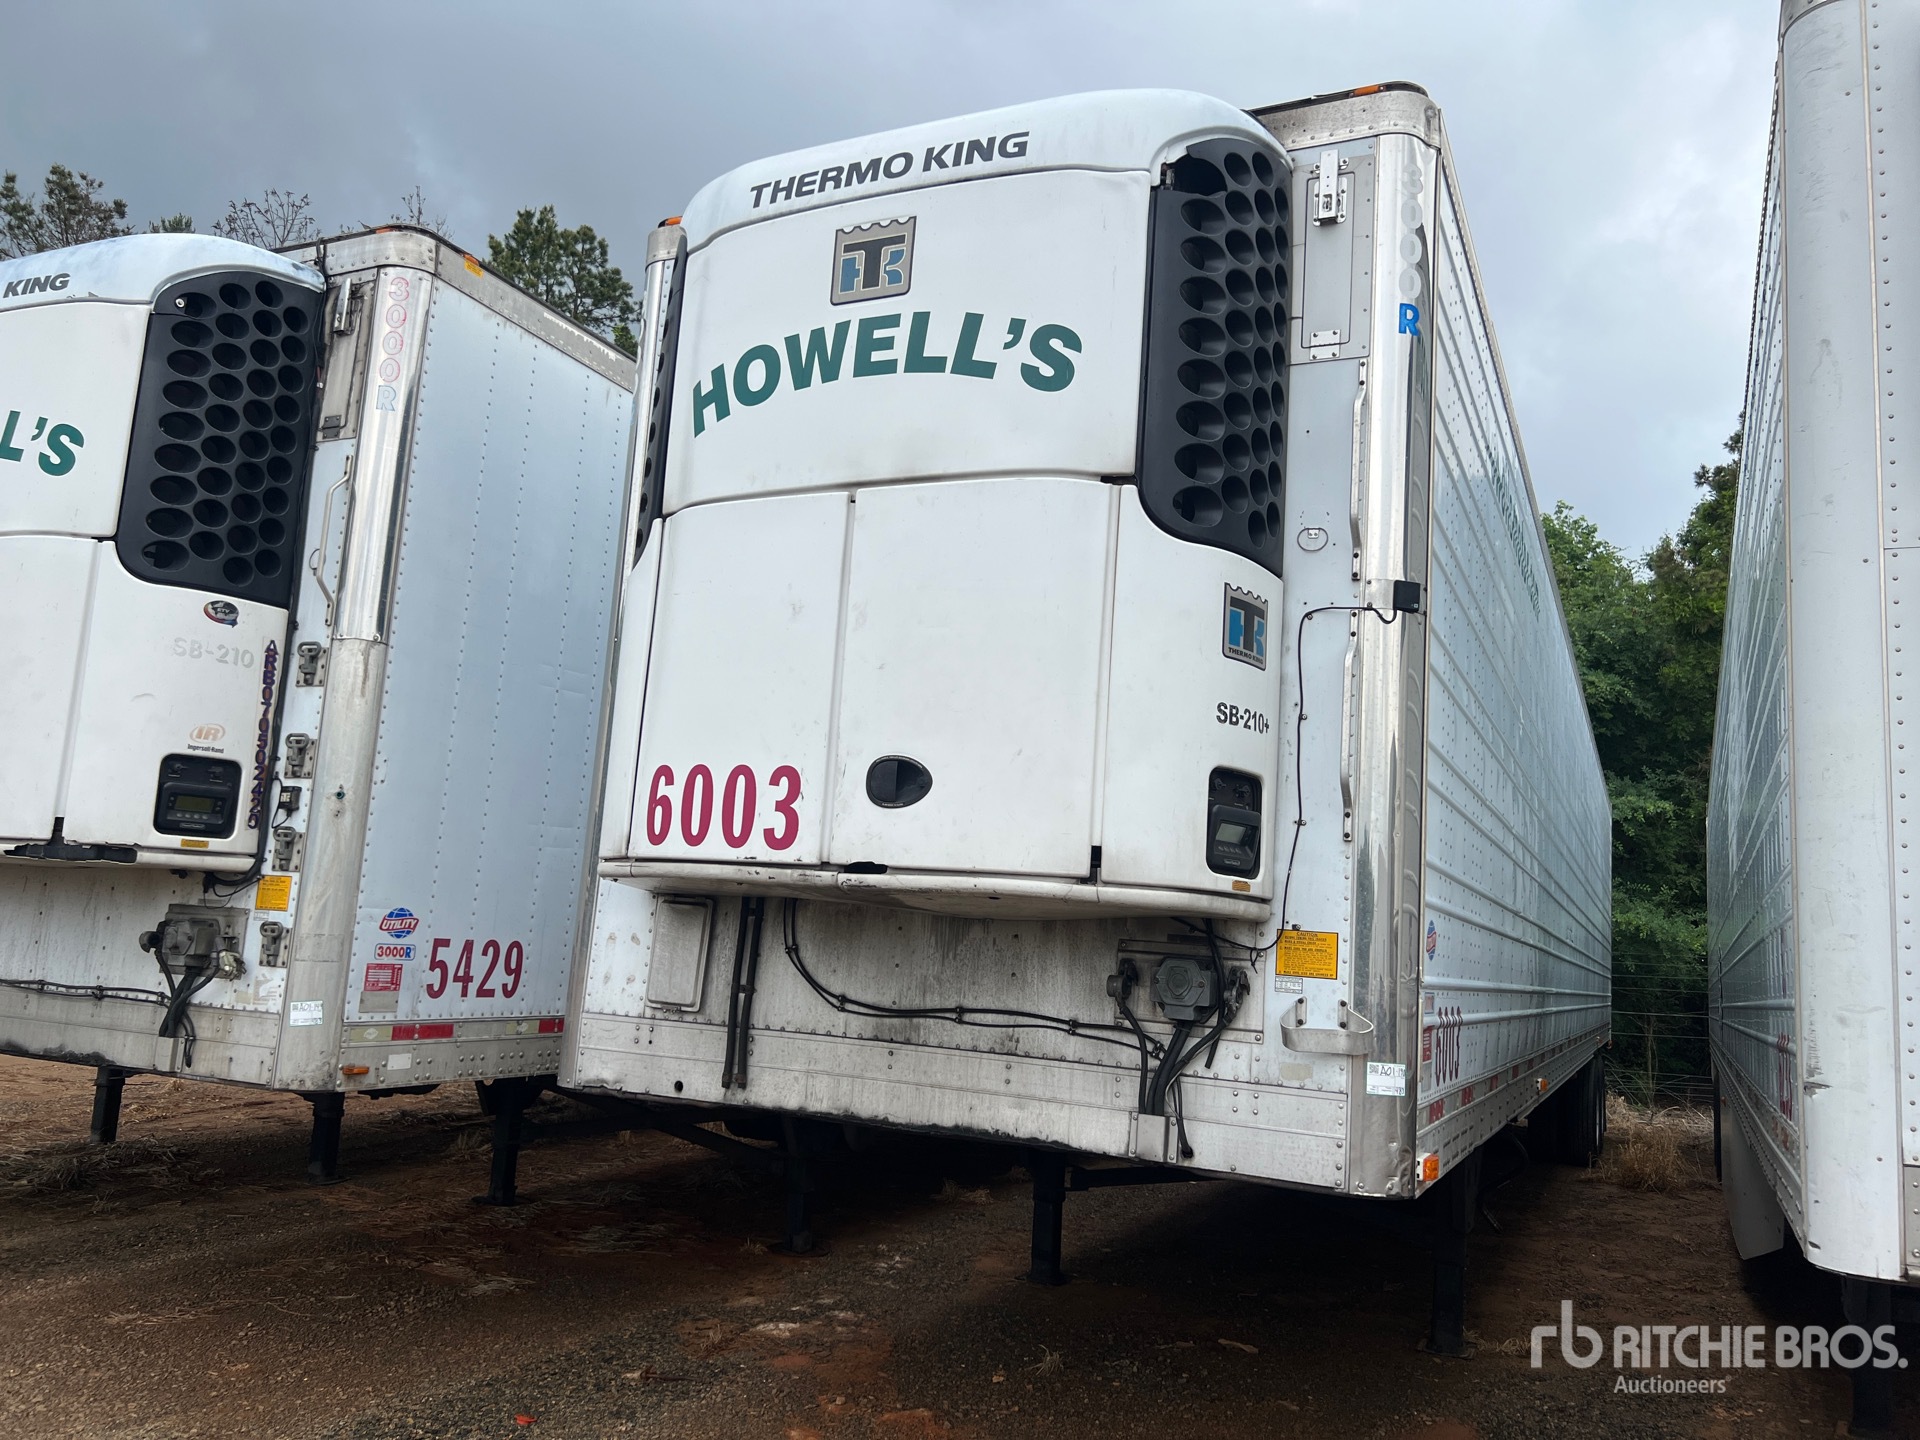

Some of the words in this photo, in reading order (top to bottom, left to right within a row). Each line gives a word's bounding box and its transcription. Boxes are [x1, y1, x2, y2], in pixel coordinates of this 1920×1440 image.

[750, 151, 914, 209] THERMO
[922, 131, 1030, 173] KING
[3, 273, 71, 298] KING
[693, 311, 1083, 438] HOWELL'S
[172, 637, 255, 668] SB-210
[1216, 702, 1270, 734] SB-210+
[646, 763, 802, 851] 6003
[381, 919, 418, 930] UTILITY
[377, 945, 412, 959] 3000R
[426, 937, 524, 999] 5429
